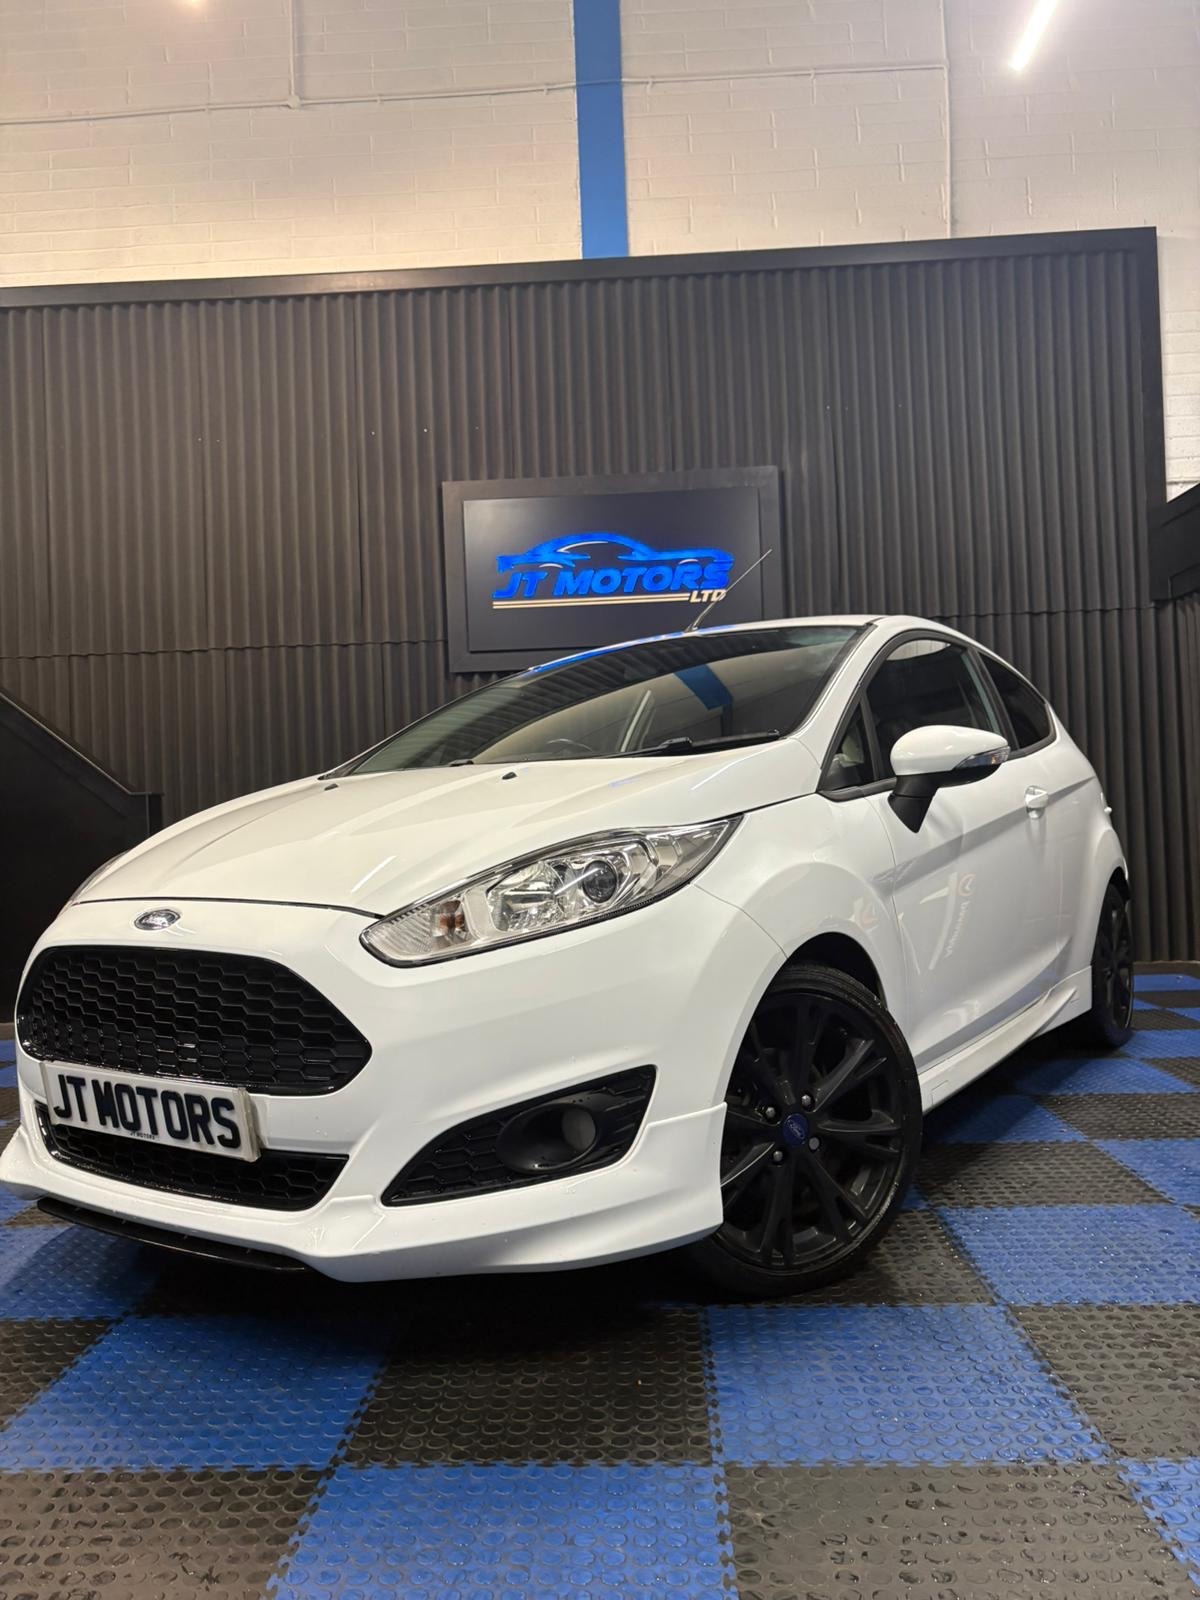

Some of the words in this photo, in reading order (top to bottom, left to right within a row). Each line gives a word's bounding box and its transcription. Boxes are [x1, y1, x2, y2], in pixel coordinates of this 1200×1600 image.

[492, 571, 548, 599] JT
[553, 564, 731, 596] MOTORS
[690, 589, 727, 603] LTD
[53, 1074, 88, 1122] JT
[91, 1079, 242, 1149] MOTORS
